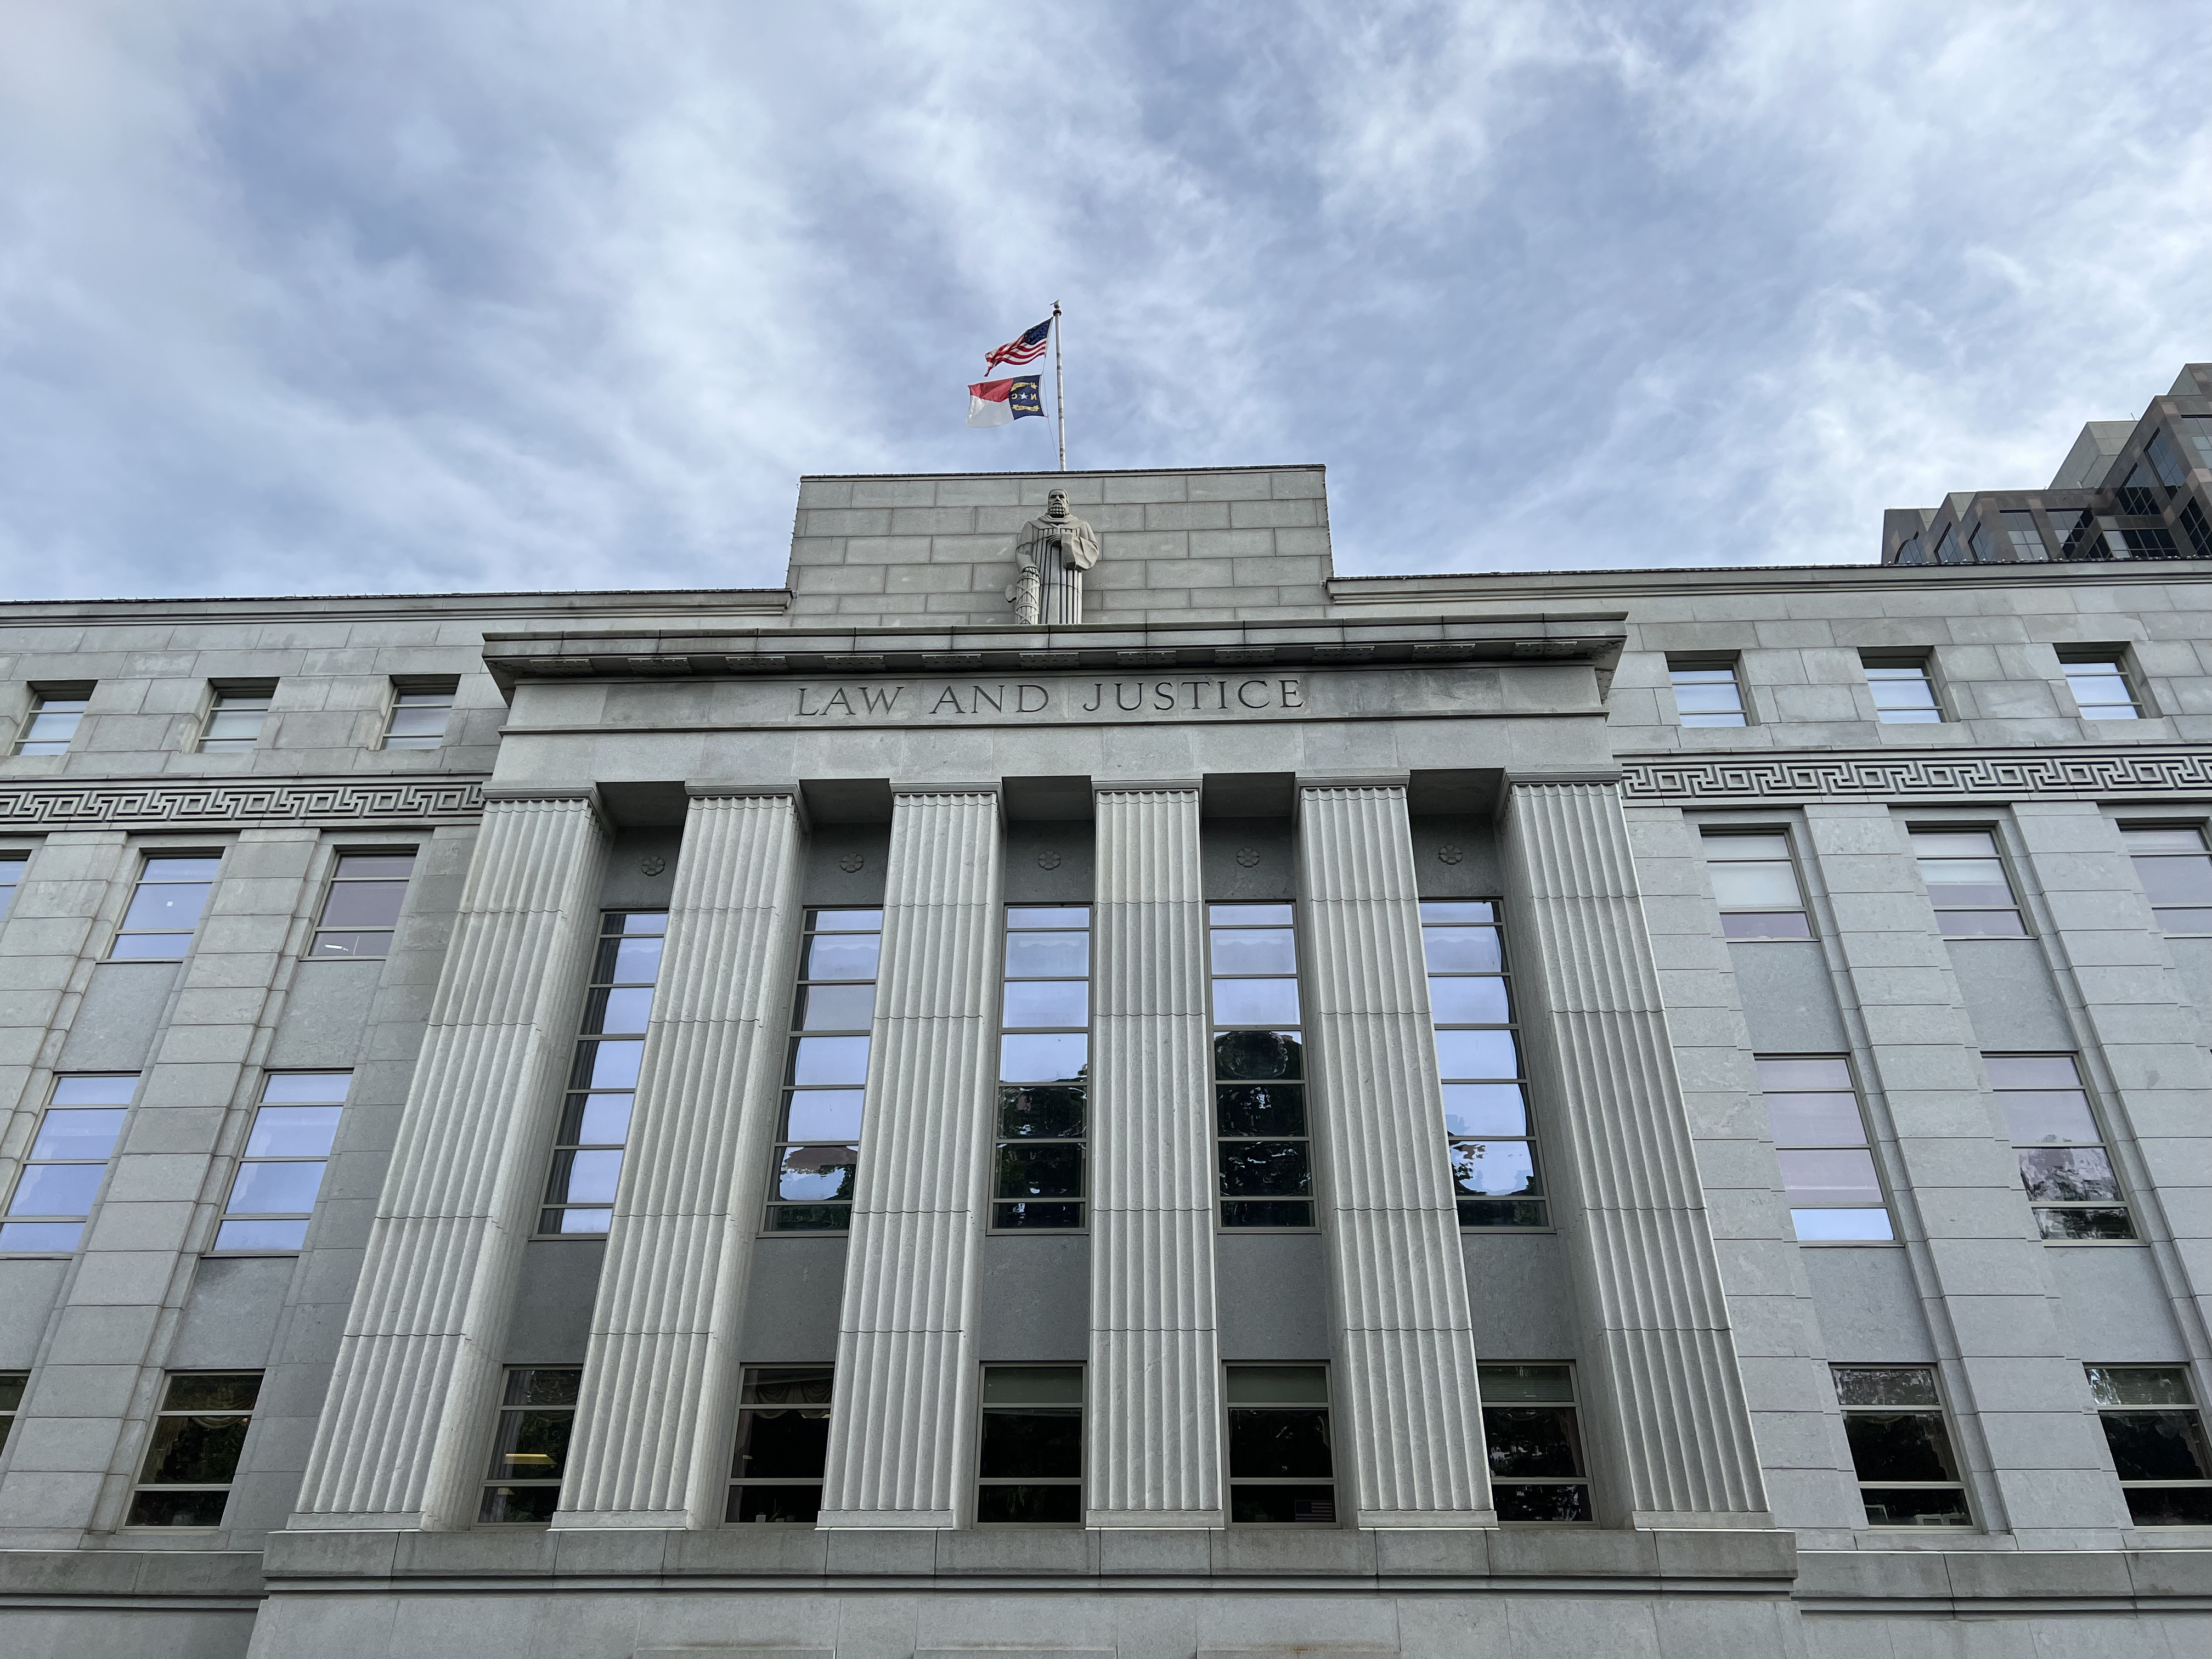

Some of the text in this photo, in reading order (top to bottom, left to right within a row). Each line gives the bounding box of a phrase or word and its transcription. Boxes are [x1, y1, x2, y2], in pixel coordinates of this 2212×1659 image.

[795, 680, 1305, 716] LAW AND JUSTICE
